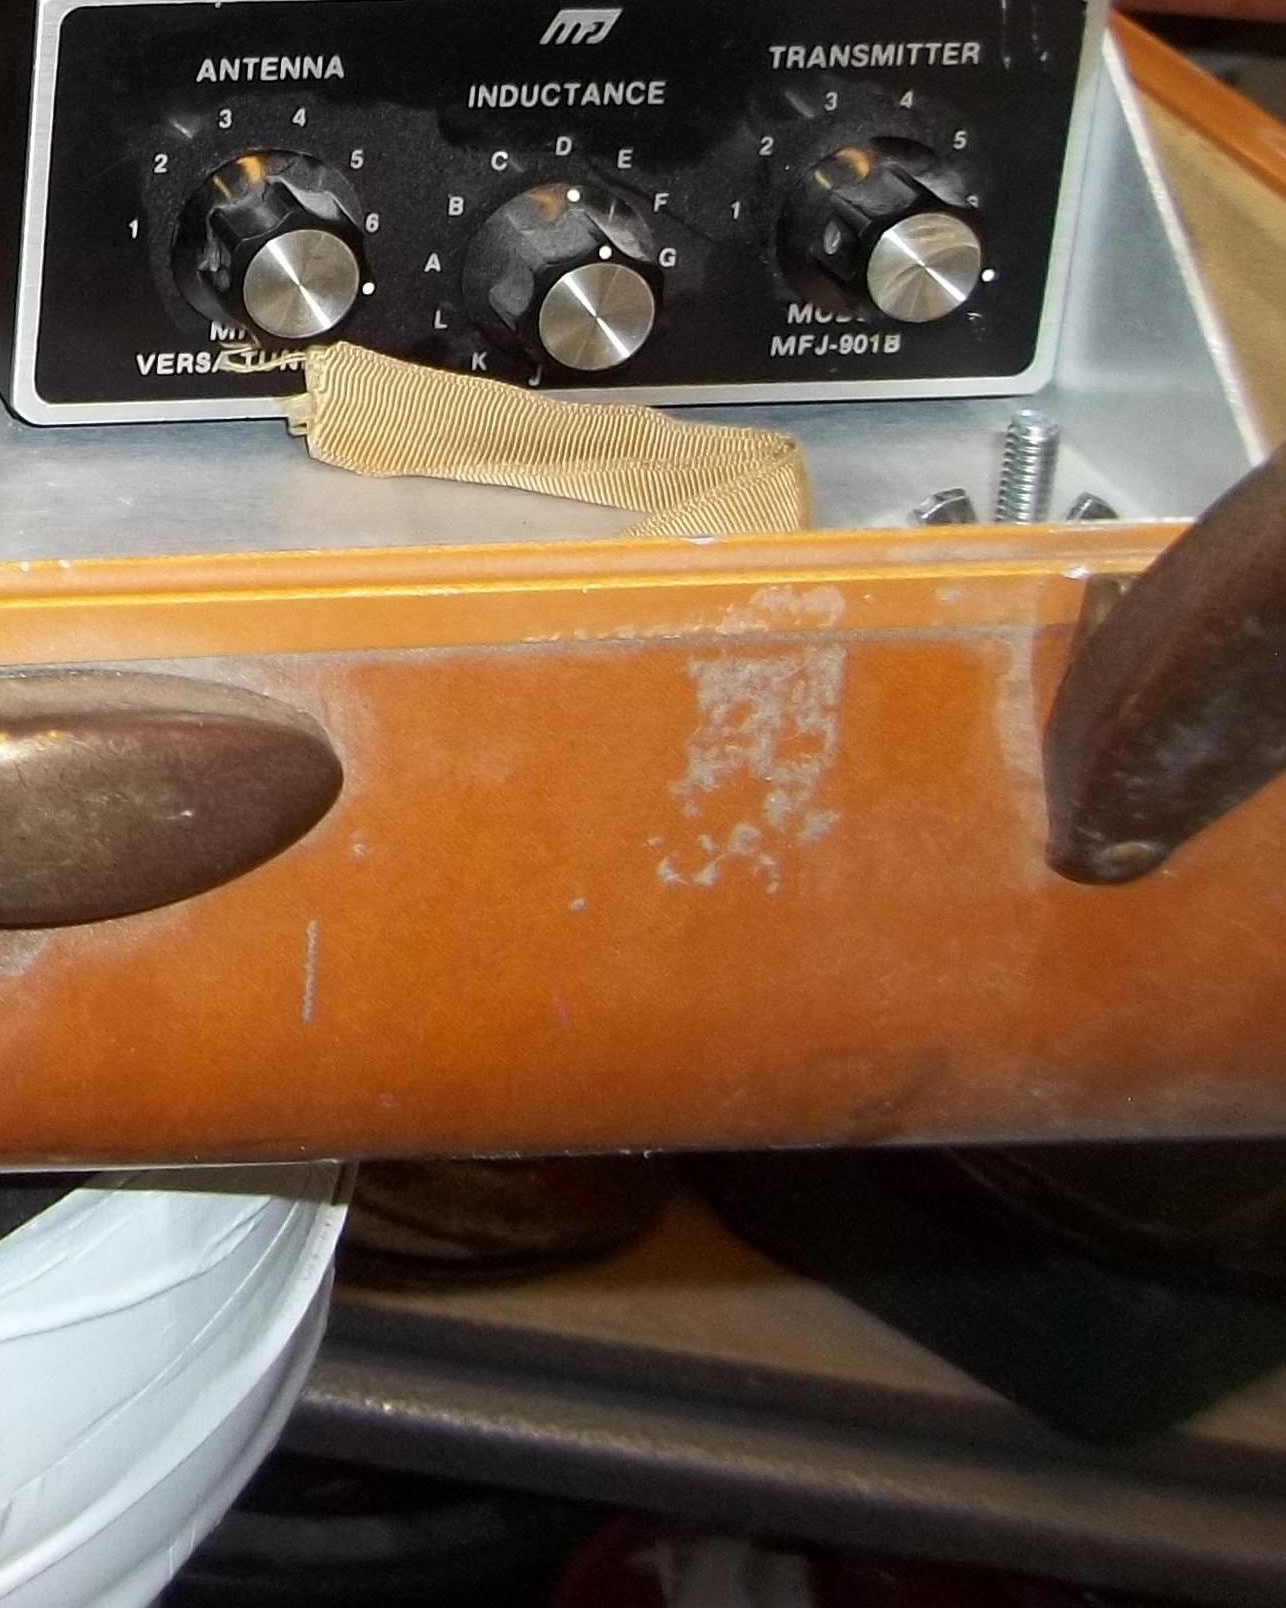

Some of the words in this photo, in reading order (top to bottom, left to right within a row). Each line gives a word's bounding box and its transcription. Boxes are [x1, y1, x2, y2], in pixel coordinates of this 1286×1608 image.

[769, 42, 980, 69] TRANSMITTER
[196, 55, 344, 82] ANTENNA
[468, 81, 666, 108] INDUCTANCE
[824, 92, 839, 111] 3
[900, 90, 913, 109] 4
[219, 109, 233, 129] 3
[292, 108, 306, 127] 4
[556, 137, 572, 155] D
[759, 137, 774, 156] 2
[954, 131, 968, 150] 5
[154, 154, 168, 174] 2
[350, 149, 364, 169] 5
[491, 152, 508, 171] C
[617, 149, 633, 168] E
[448, 196, 464, 215] B
[654, 193, 669, 212] F
[731, 201, 741, 220] 1
[129, 219, 139, 240] 1
[365, 213, 380, 233] 6
[425, 253, 441, 272] A
[659, 248, 676, 267] G
[434, 310, 447, 329] L
[770, 333, 901, 356] MFJ-901B
[472, 352, 488, 371] K
